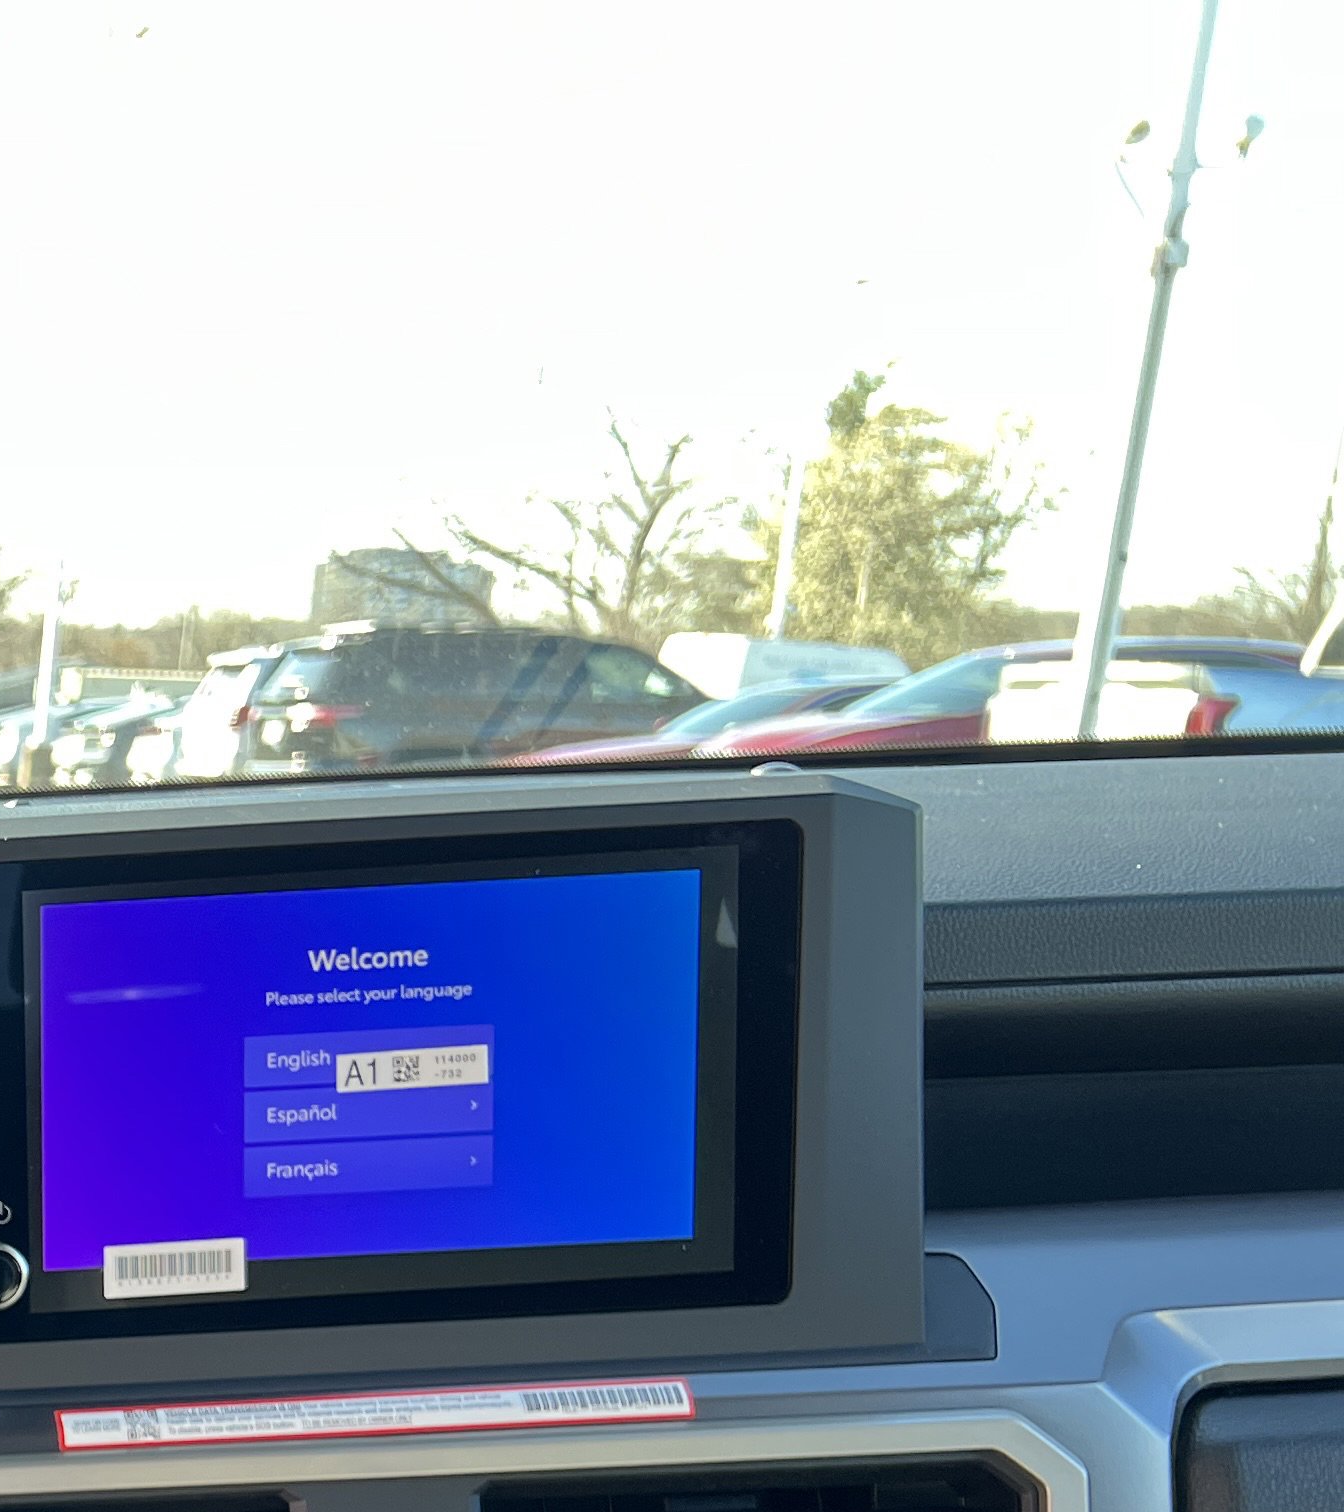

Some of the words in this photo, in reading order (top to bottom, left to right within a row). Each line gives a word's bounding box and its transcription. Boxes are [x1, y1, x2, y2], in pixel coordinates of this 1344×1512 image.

[308, 947, 429, 972] Welcome
[265, 992, 313, 1007] Please
[317, 988, 360, 1004] select
[363, 986, 398, 1004] your
[401, 984, 473, 1002] language
[267, 1049, 331, 1072] English
[345, 1058, 377, 1088] A1
[267, 1104, 337, 1126] Español
[267, 1160, 339, 1181] Français
